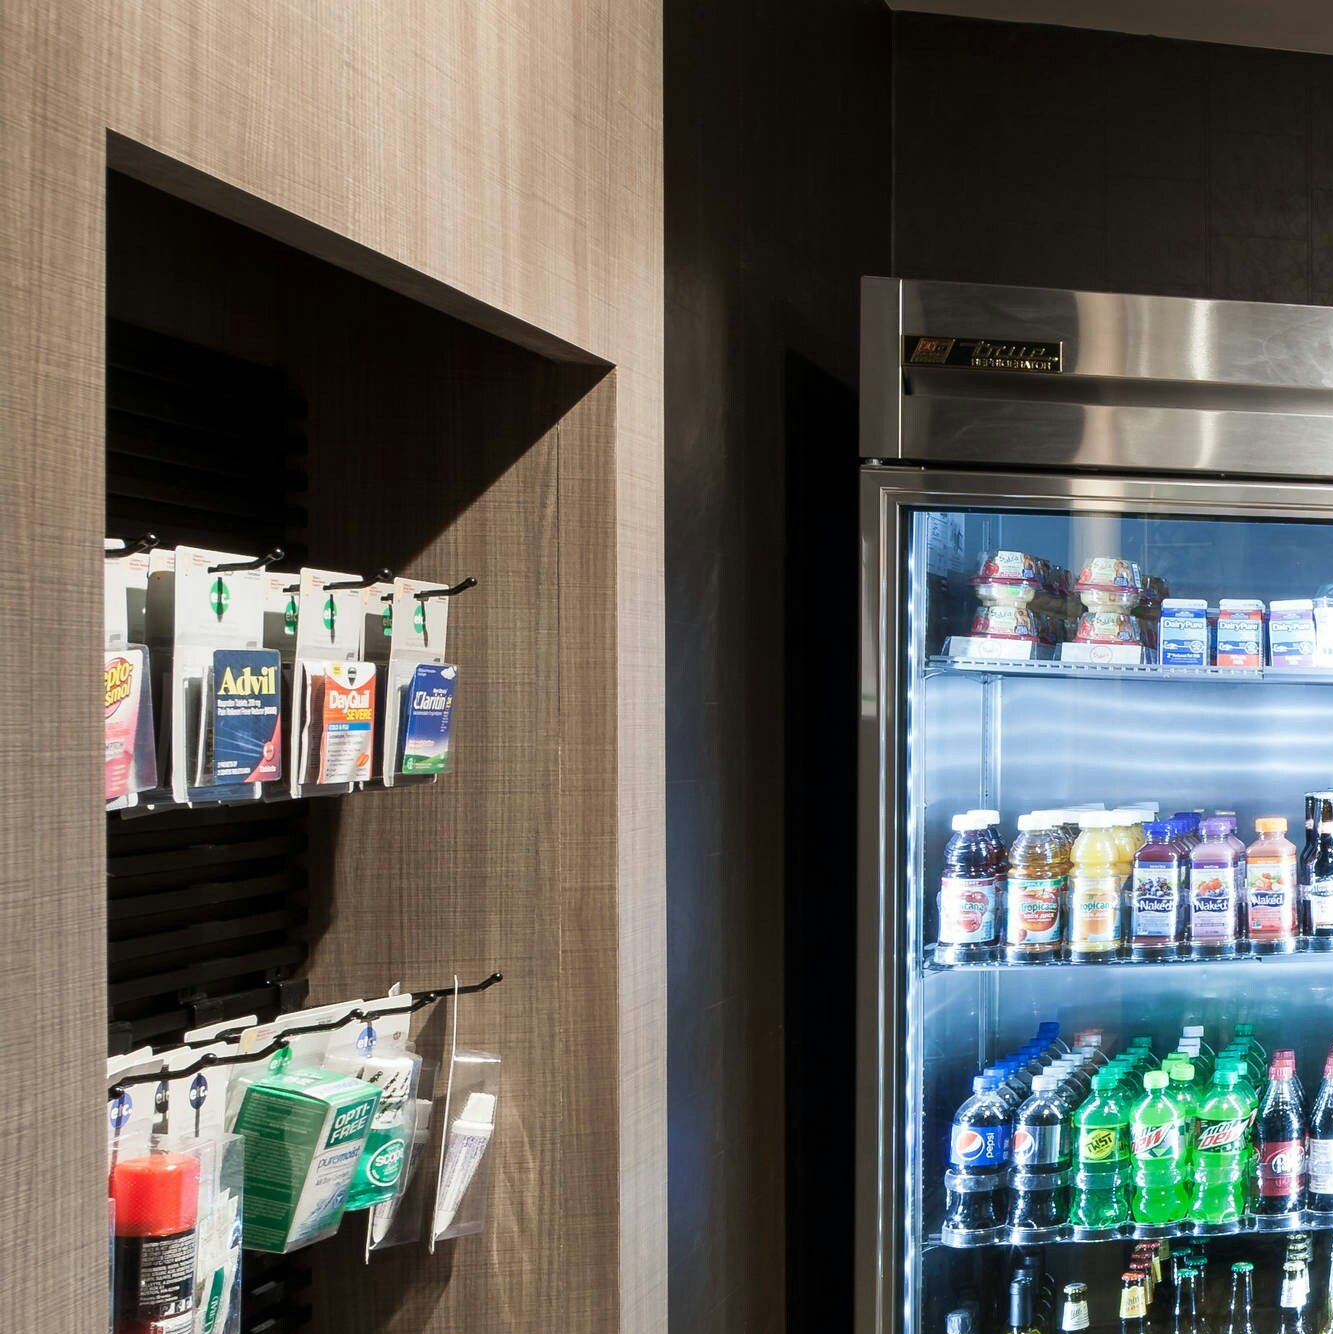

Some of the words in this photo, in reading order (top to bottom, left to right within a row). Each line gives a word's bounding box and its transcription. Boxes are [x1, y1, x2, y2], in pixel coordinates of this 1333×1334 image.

[1163, 620, 1204, 631] DairyPure
[1219, 621, 1258, 631] DairyPure
[216, 665, 276, 696] Advil
[328, 690, 371, 714] DayQuil
[413, 691, 446, 711] Claritin
[346, 708, 373, 721] SEVERE
[1139, 900, 1173, 911] Naked
[1197, 900, 1228, 912] Naked
[1253, 894, 1283, 906] Naked
[335, 1103, 371, 1130] OPTI-
[329, 1118, 367, 1145] FREE
[986, 1132, 995, 1158] pepsi
